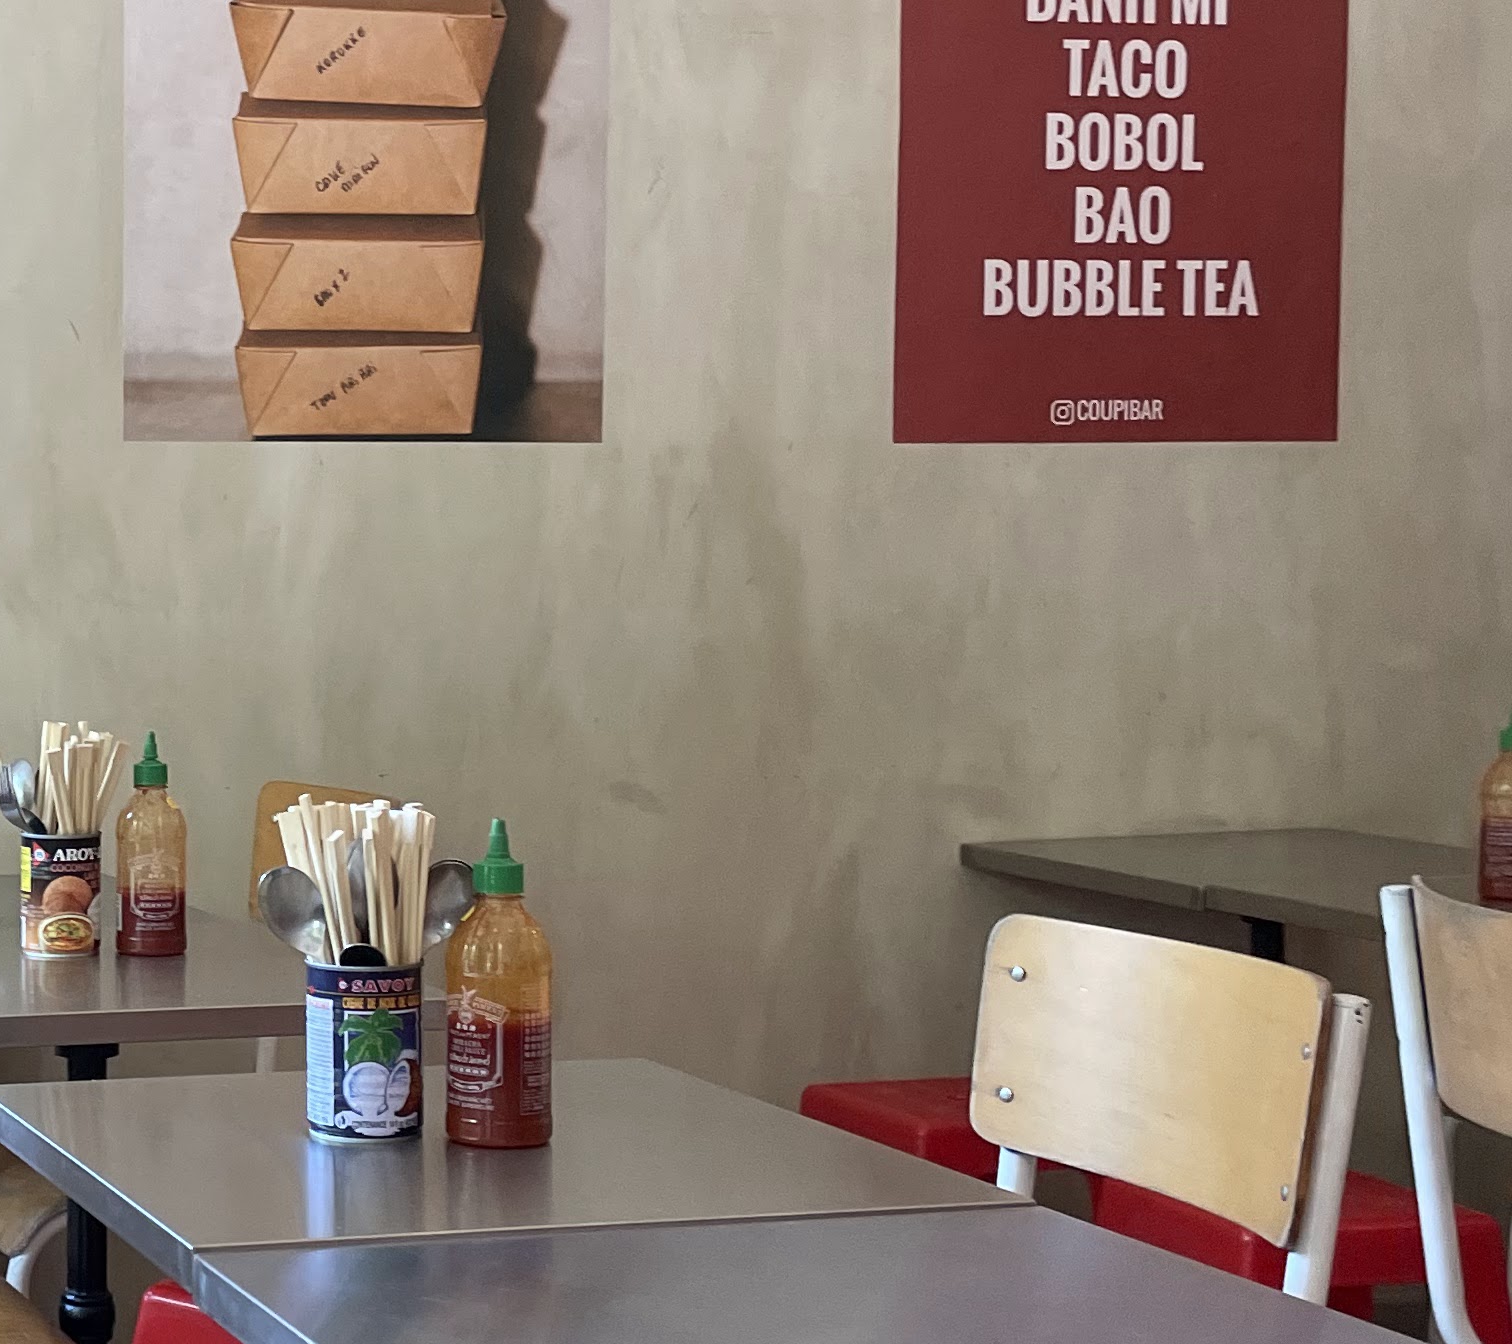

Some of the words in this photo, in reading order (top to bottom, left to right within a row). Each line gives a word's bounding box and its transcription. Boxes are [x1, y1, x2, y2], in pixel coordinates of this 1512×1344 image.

[1063, 39, 1188, 99] TACO
[1045, 112, 1204, 172] BOBOL
[1074, 186, 1171, 245] BAO
[983, 259, 1165, 317] BUBBLE
[1177, 259, 1259, 317] TEA
[1076, 399, 1164, 423] COUPIBAR
[350, 977, 416, 993] SAVOY
